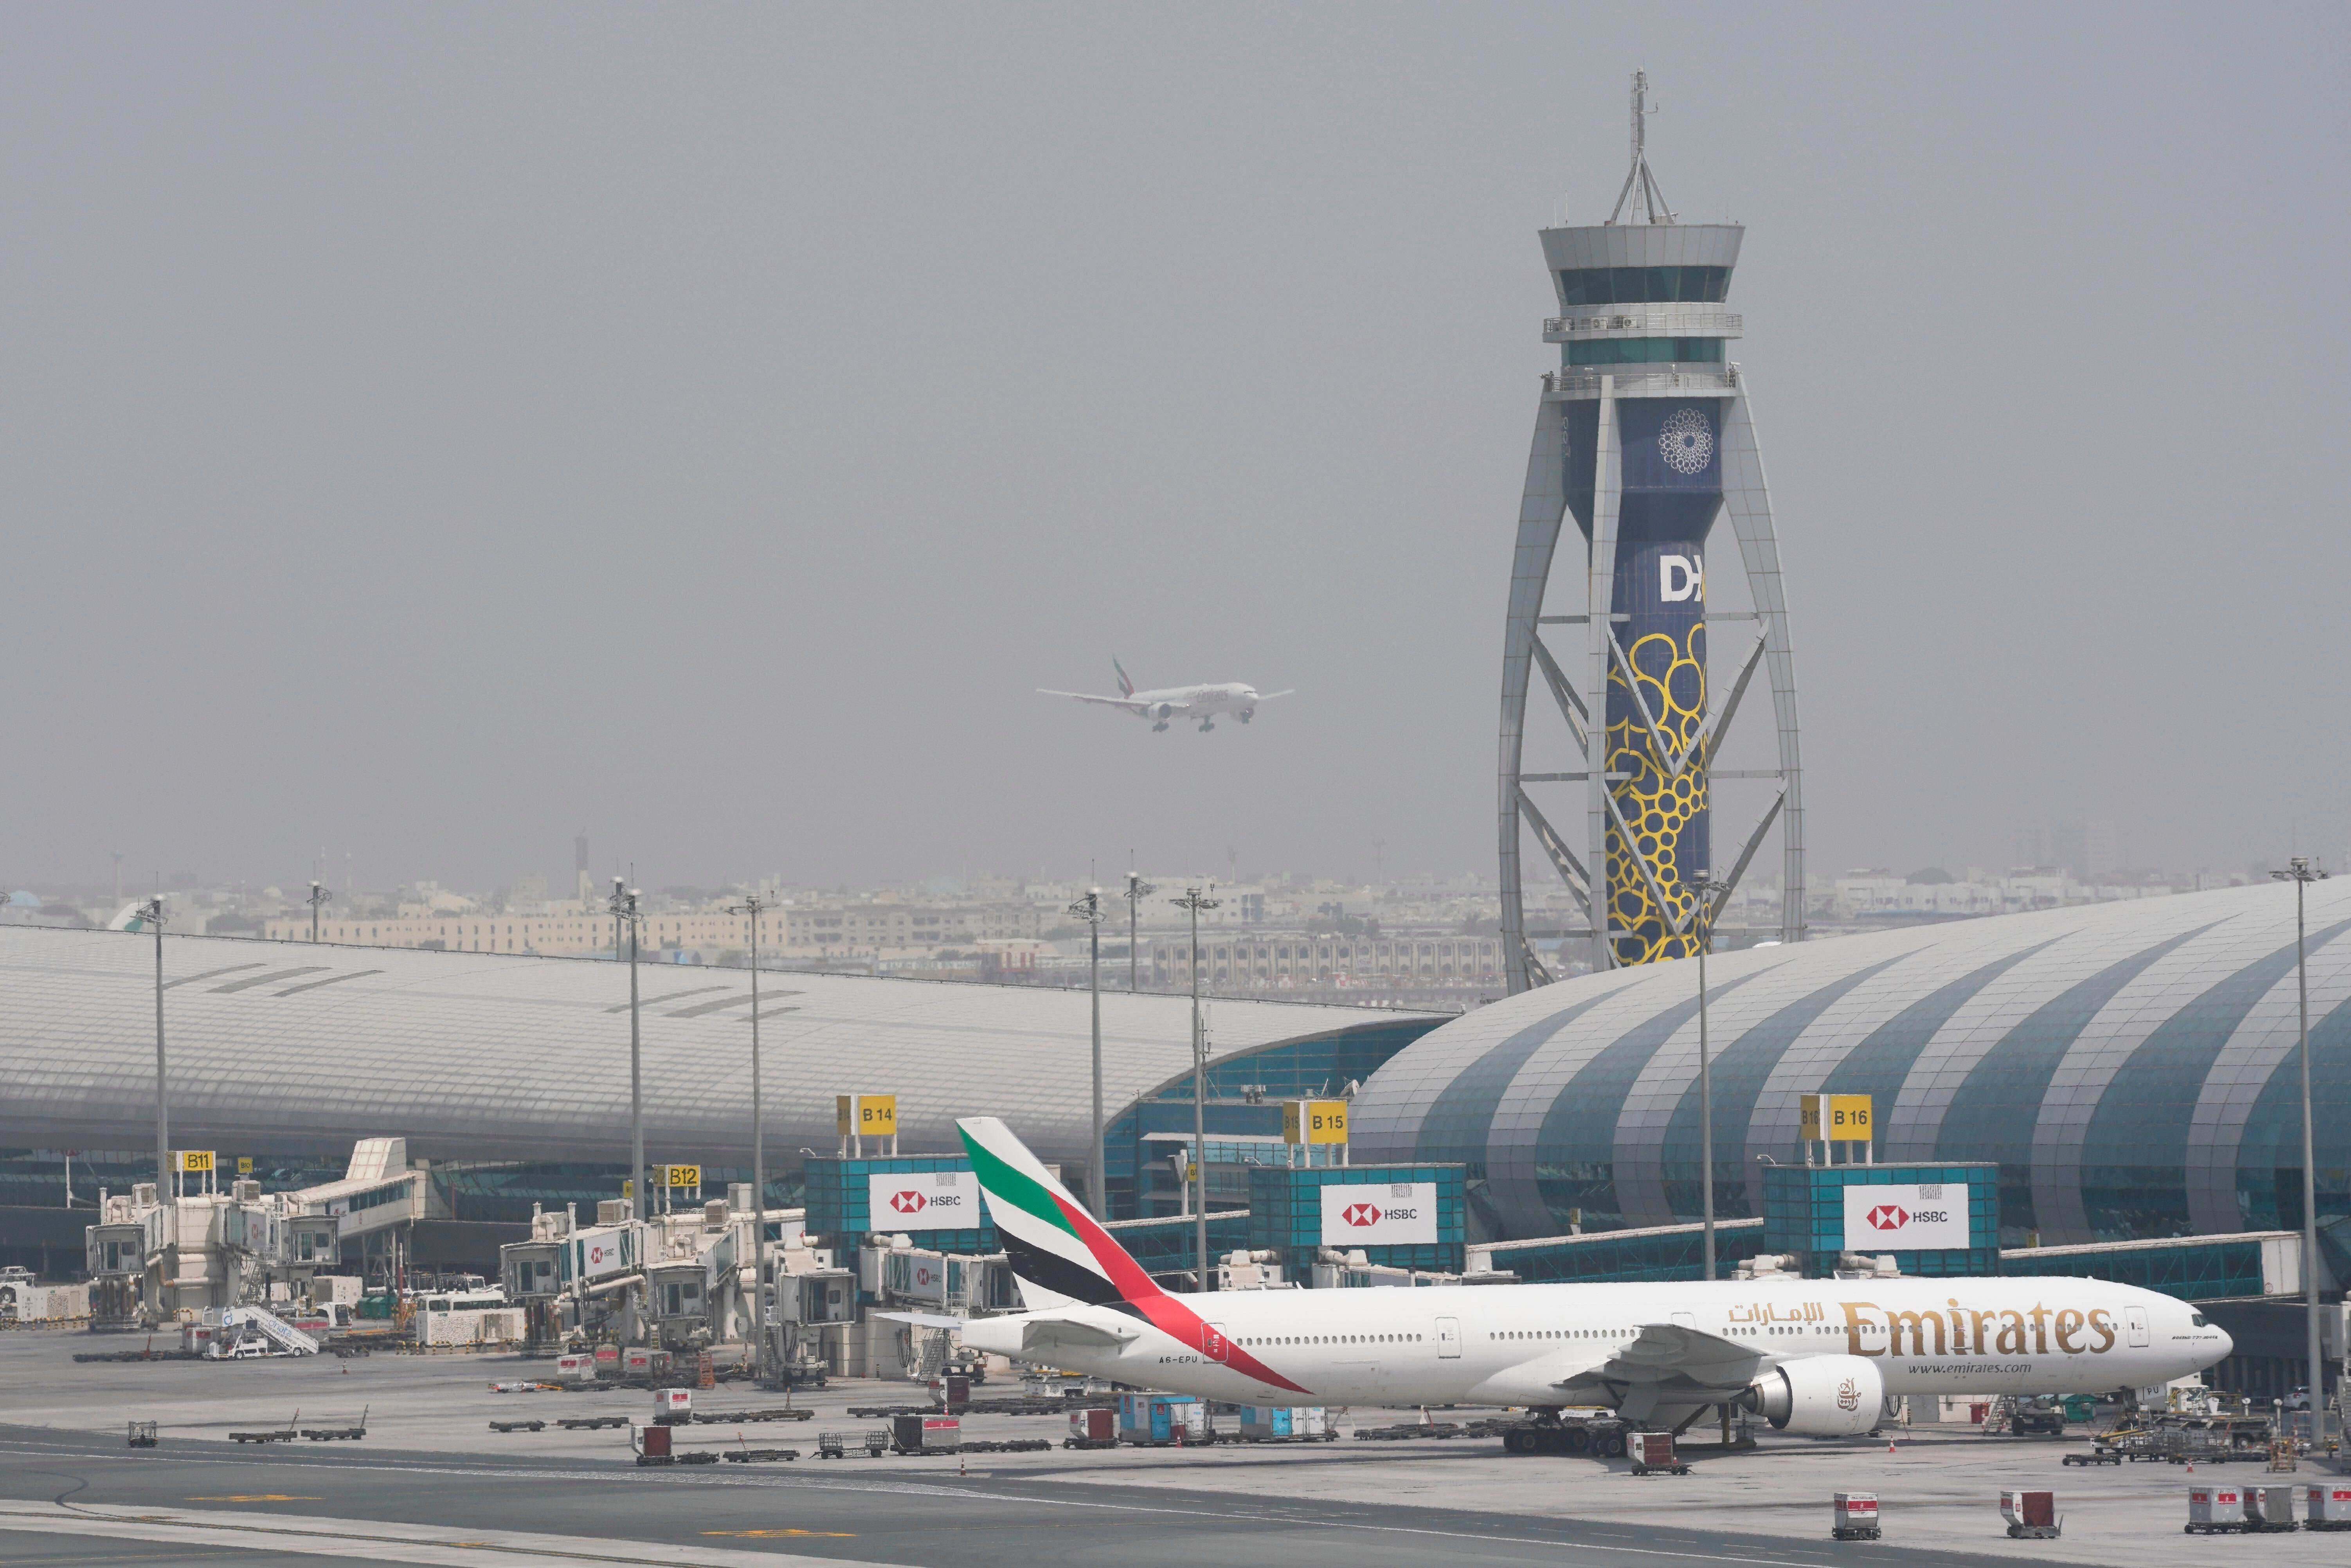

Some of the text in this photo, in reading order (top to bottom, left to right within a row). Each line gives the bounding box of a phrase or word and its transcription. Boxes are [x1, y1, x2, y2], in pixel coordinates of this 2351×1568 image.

[863, 1108, 892, 1121] B 14
[1834, 1110, 1867, 1125] B 16
[1313, 1115, 1343, 1129] B 15
[188, 1154, 209, 1168] B11
[670, 1168, 697, 1185] B12
[931, 1196, 961, 1206] HSBC
[1385, 1208, 1417, 1219] HSBC
[1913, 1211, 1948, 1223] HSBC
[1729, 1302, 1824, 1326] الإمارات
[1838, 1298, 2115, 1356] Emirates
[1159, 1356, 1197, 1364] A6-EPU
[1908, 1362, 2032, 1375] www.emirates.com
[2147, 1386, 2159, 1395] PU
